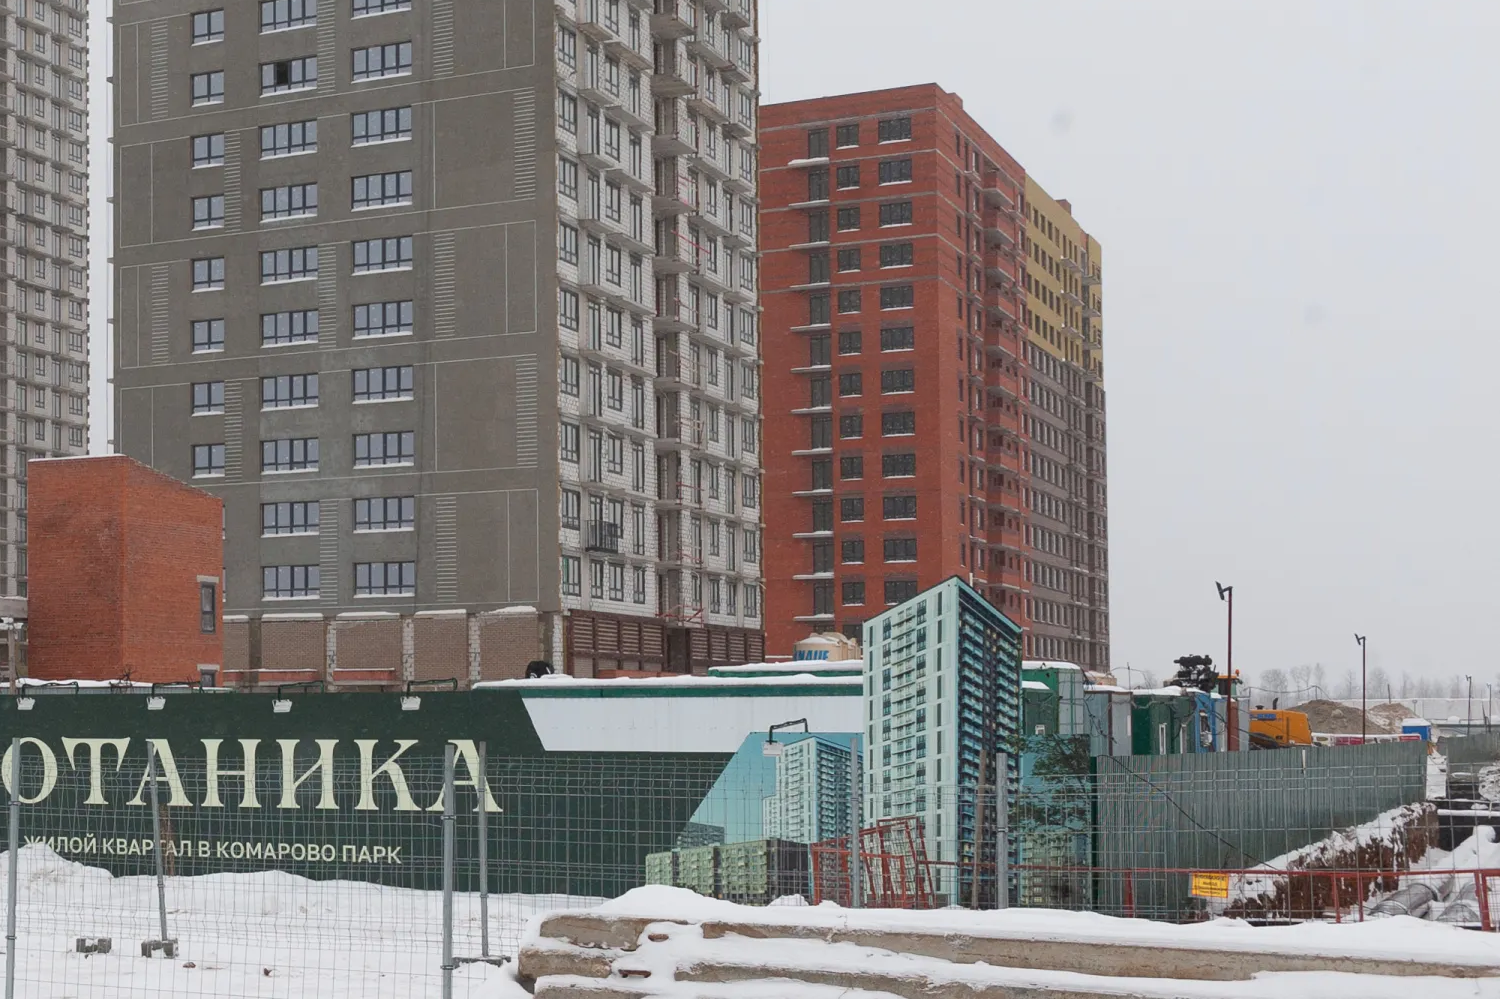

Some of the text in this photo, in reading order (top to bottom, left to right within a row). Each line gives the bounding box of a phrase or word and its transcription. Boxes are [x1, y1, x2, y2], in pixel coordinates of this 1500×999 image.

[198, 840, 211, 858] В
[216, 841, 336, 862] КОМАРОВО
[342, 845, 402, 864] ПАРК
